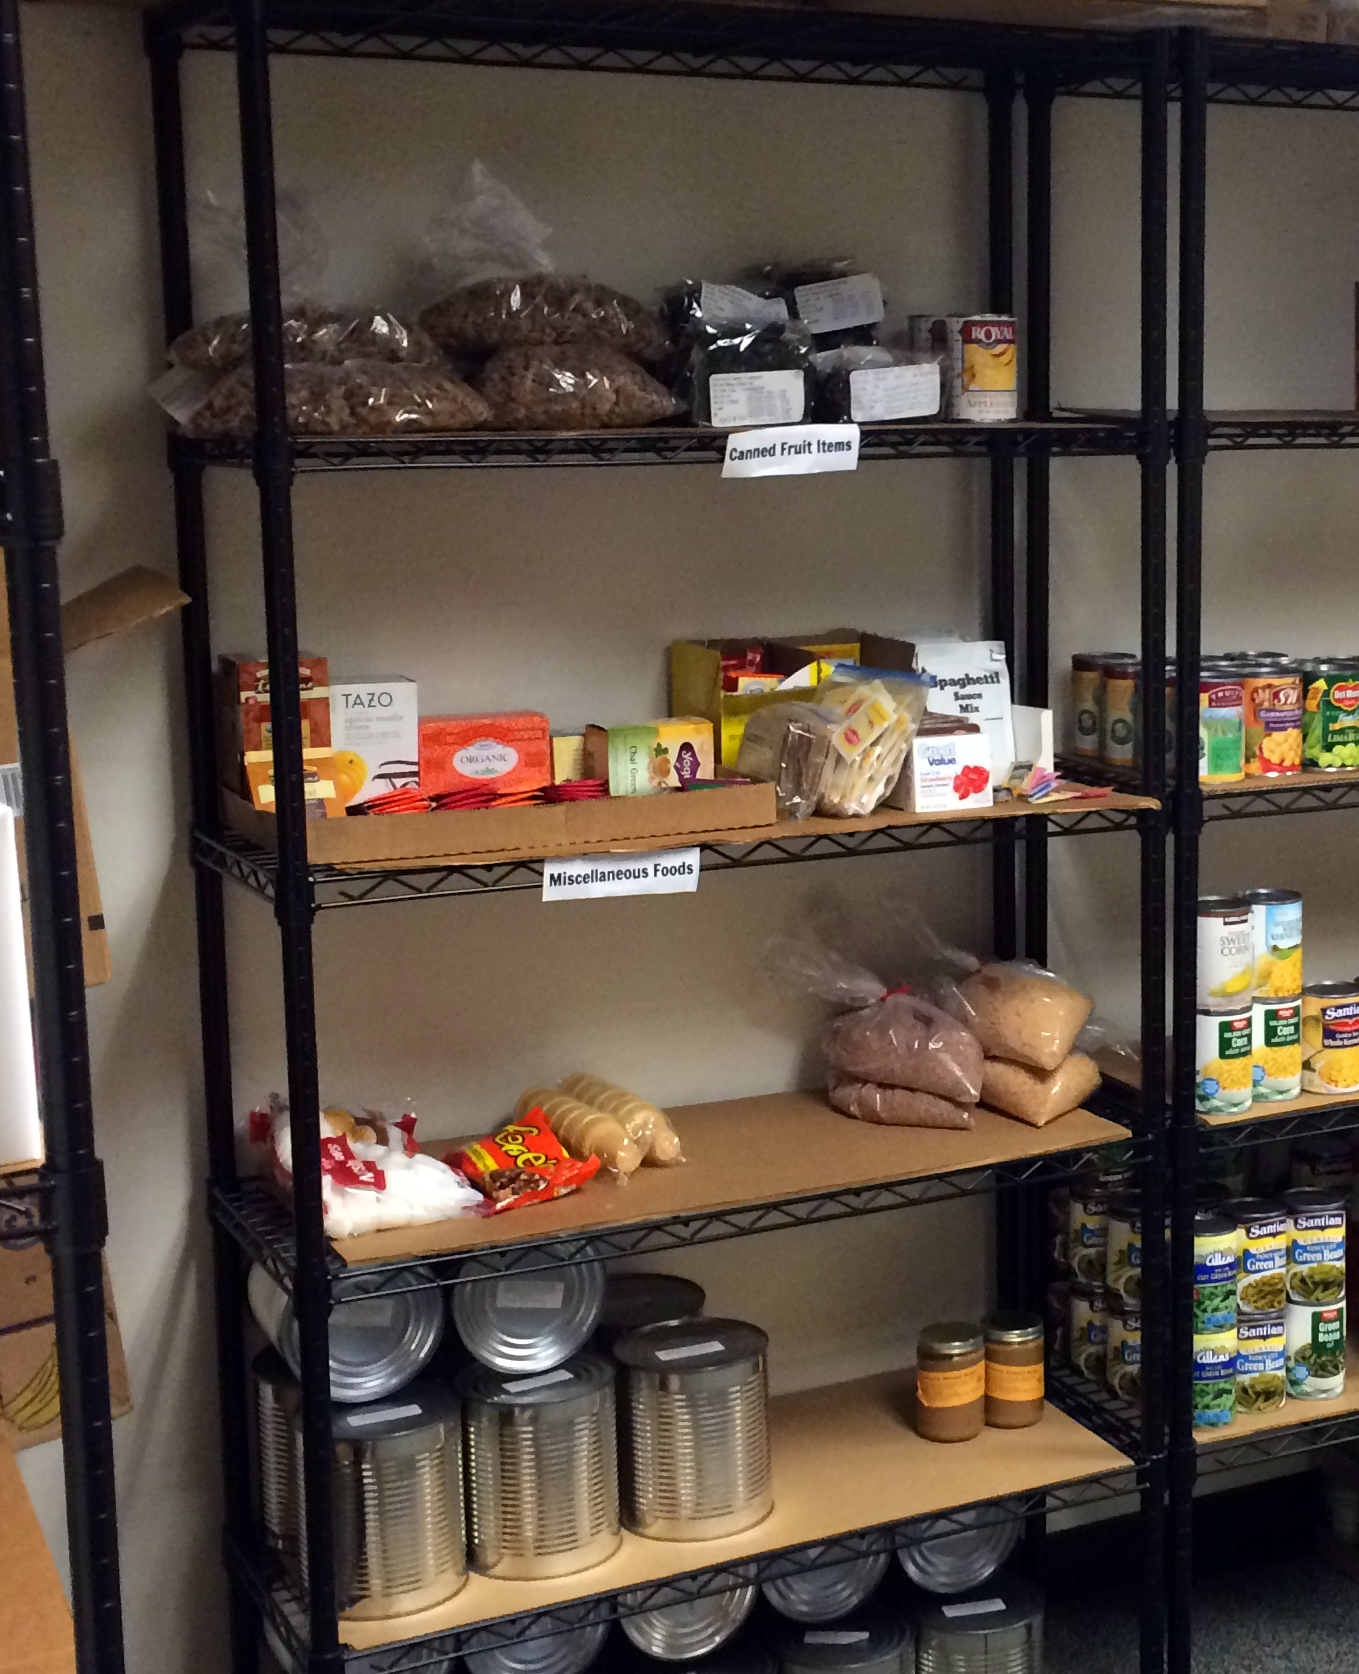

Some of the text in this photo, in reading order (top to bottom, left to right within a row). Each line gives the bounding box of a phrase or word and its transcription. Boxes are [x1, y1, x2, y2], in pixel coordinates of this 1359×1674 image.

[972, 326, 1014, 342] ROYAL
[729, 440, 852, 461] Canned Fruit Items
[341, 692, 393, 709] TAZO
[953, 691, 983, 701] Sauce
[959, 703, 980, 713] Mix
[629, 745, 637, 765] Chai
[927, 756, 956, 766] Value
[549, 861, 694, 887] Miscellaneous Foods
[1297, 1215, 1342, 1228] Santiam
[1295, 1249, 1322, 1261] Green
[1247, 1258, 1273, 1271] Green
[1238, 1324, 1284, 1339] Santiam
[1318, 1321, 1340, 1332] Green
[1318, 1331, 1341, 1342] Beans
[1236, 1359, 1264, 1371] Green
